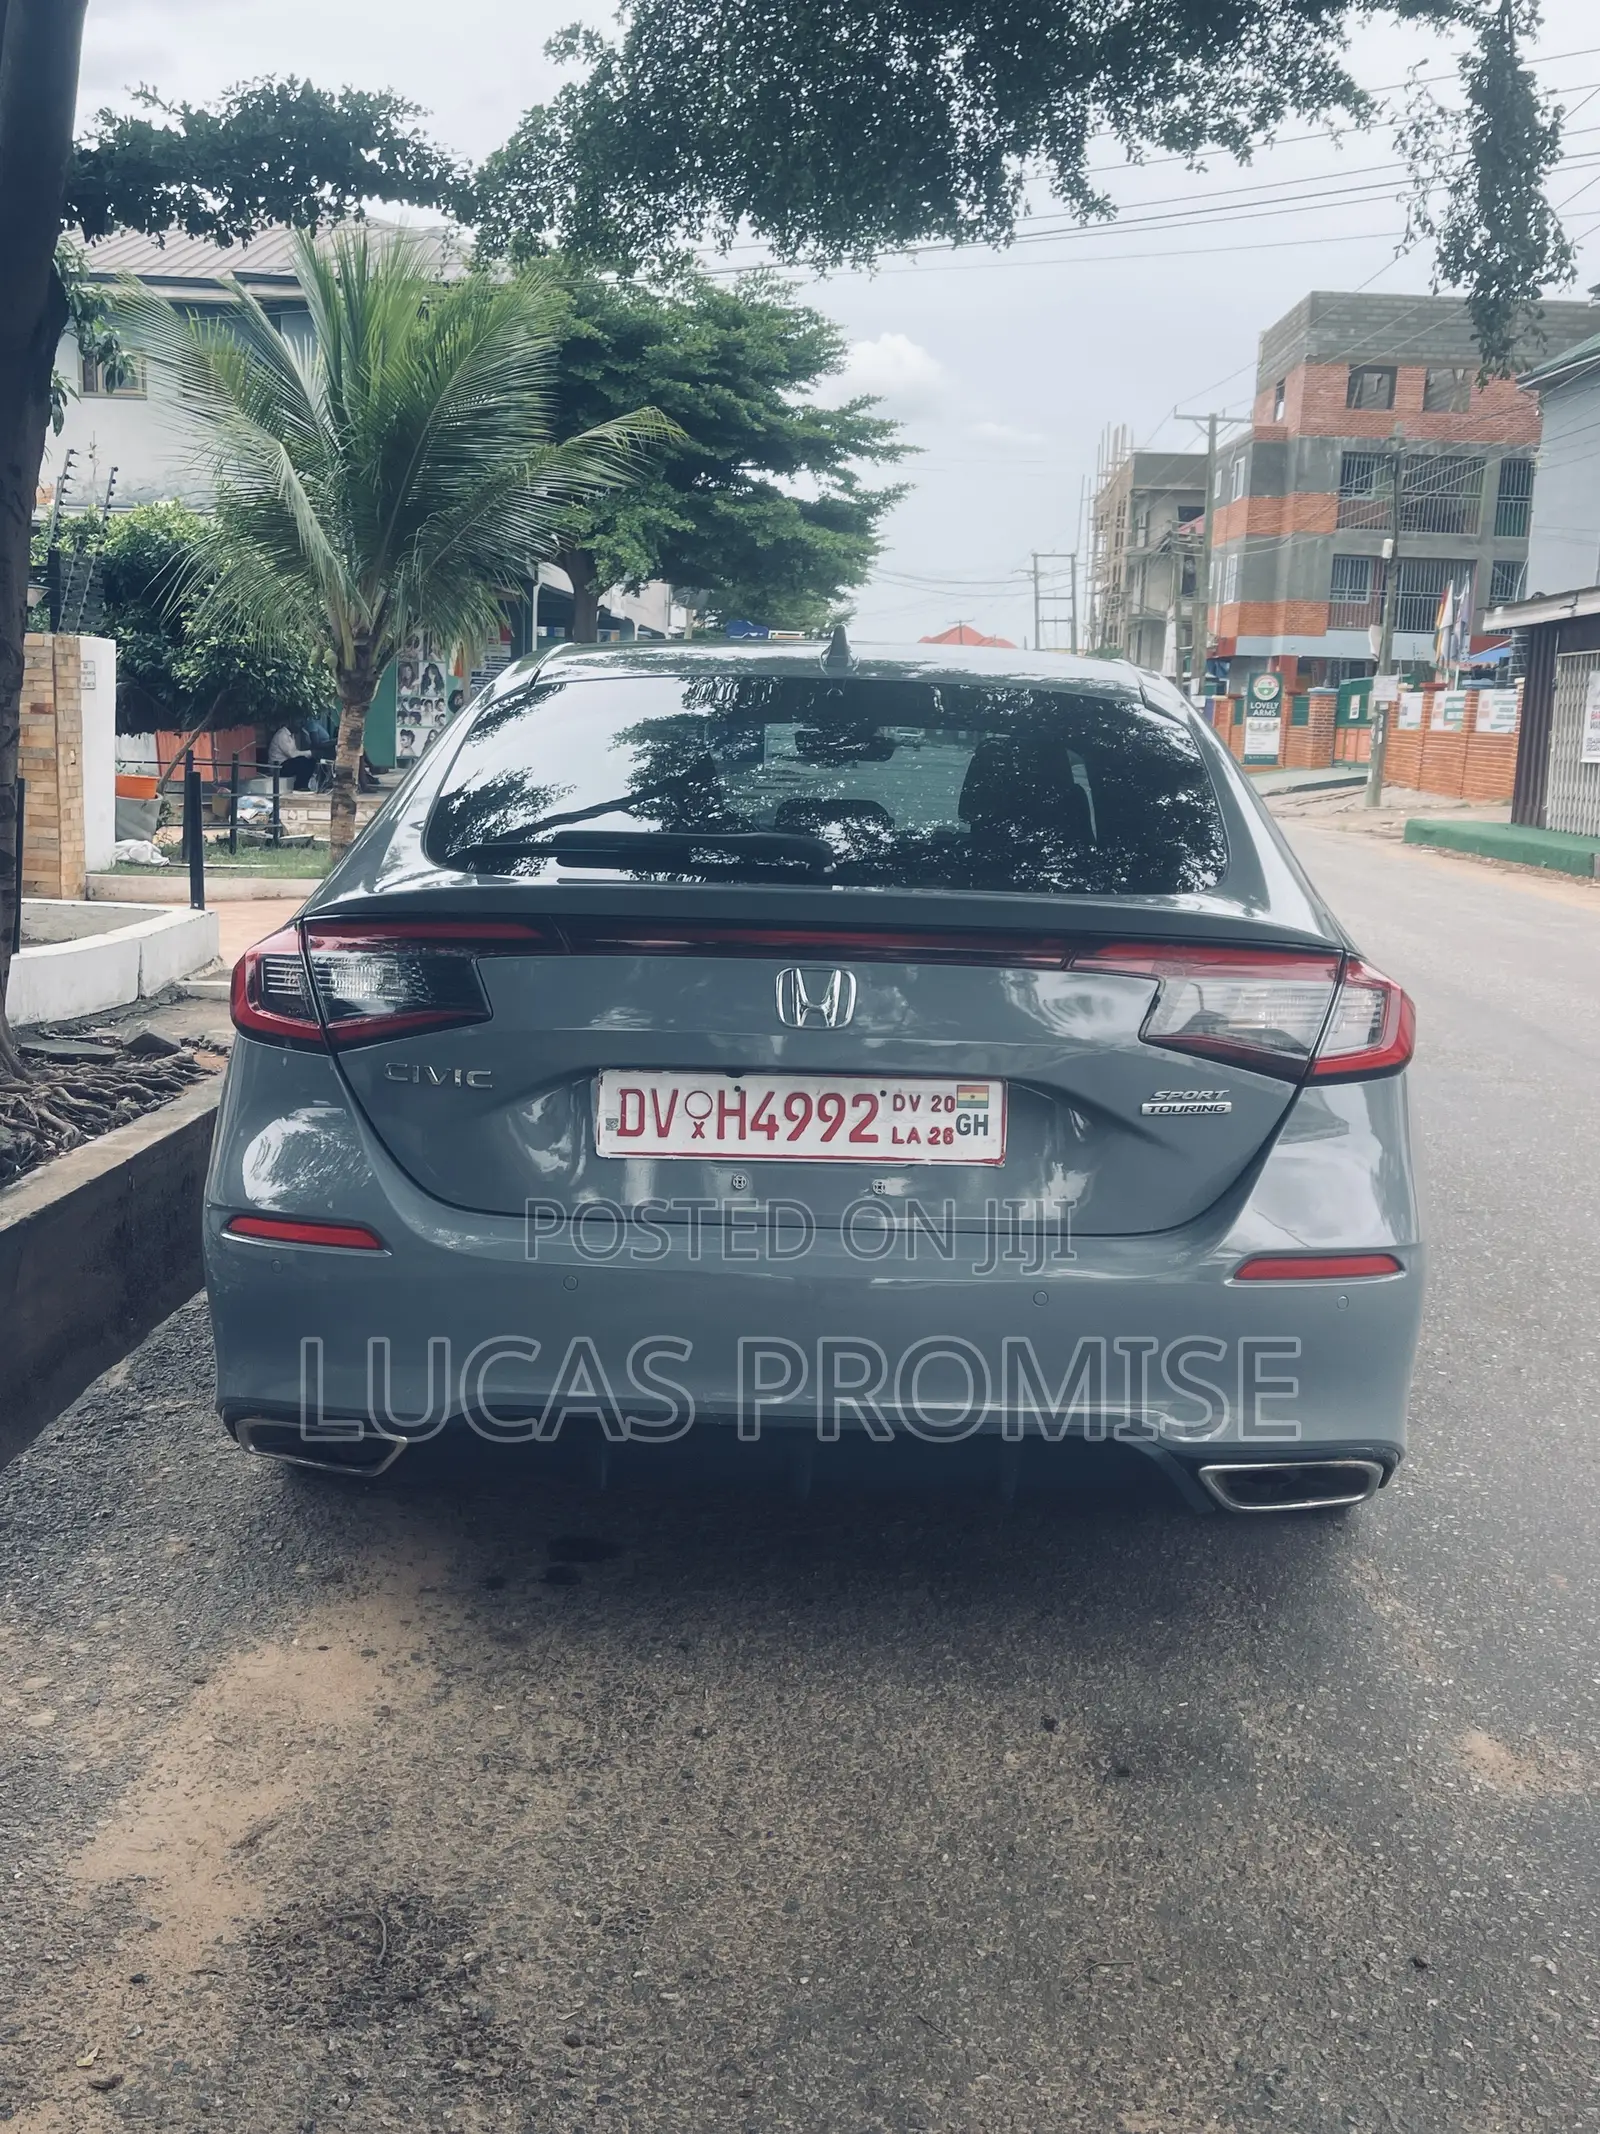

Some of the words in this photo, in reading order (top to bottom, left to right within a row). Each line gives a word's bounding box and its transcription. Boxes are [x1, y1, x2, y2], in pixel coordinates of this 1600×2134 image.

[1250, 702, 1279, 710] LOVELY
[1252, 709, 1276, 717] ARMS
[384, 1062, 493, 1088] CIVIC
[892, 1093, 921, 1112] DV
[930, 1094, 956, 1113] 20
[1149, 1089, 1230, 1102] SPORT
[616, 1088, 679, 1138] DV
[716, 1089, 880, 1144] H4992
[1147, 1104, 1227, 1114] TOURING
[955, 1113, 989, 1137] GH
[891, 1126, 922, 1145] LA
